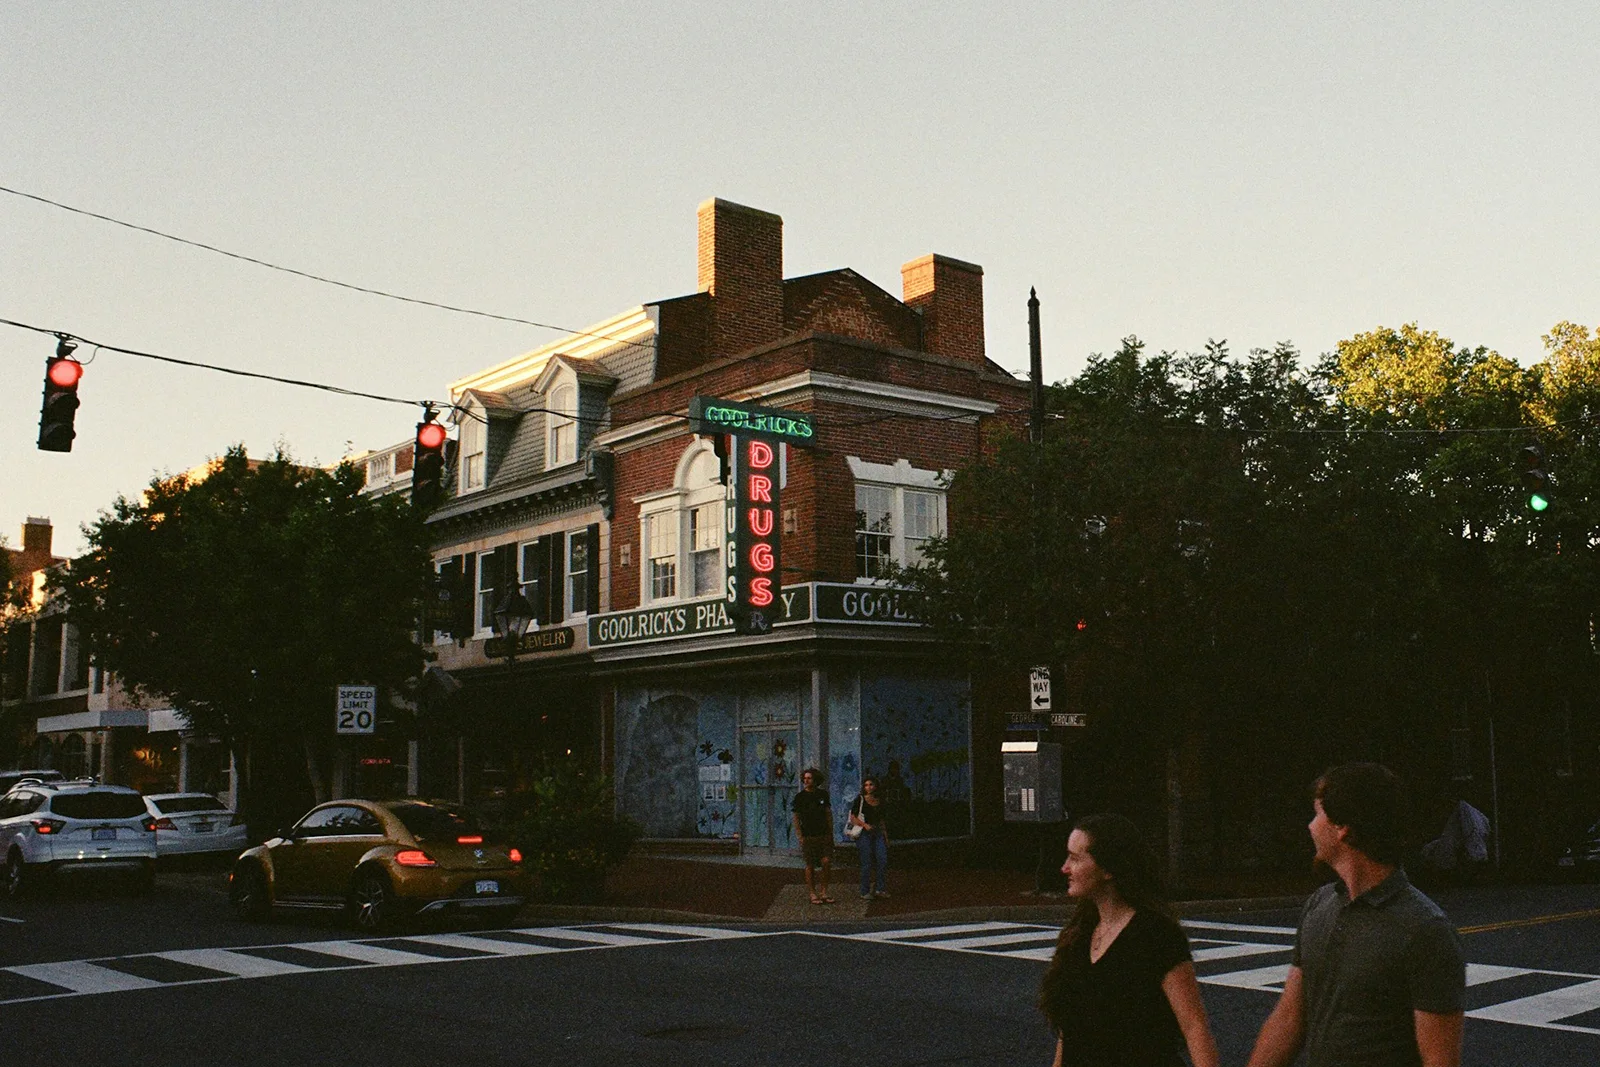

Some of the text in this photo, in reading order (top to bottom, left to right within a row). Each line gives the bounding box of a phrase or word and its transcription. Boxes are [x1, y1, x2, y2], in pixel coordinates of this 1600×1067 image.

[748, 440, 775, 607] DRUGS
[598, 608, 687, 642] GOOLRICK'S
[1033, 682, 1048, 692] WAY
[340, 691, 374, 699] SPEED
[342, 701, 369, 709] LIMIT
[339, 711, 372, 729] 20
[1051, 714, 1078, 725] CAROLINE
